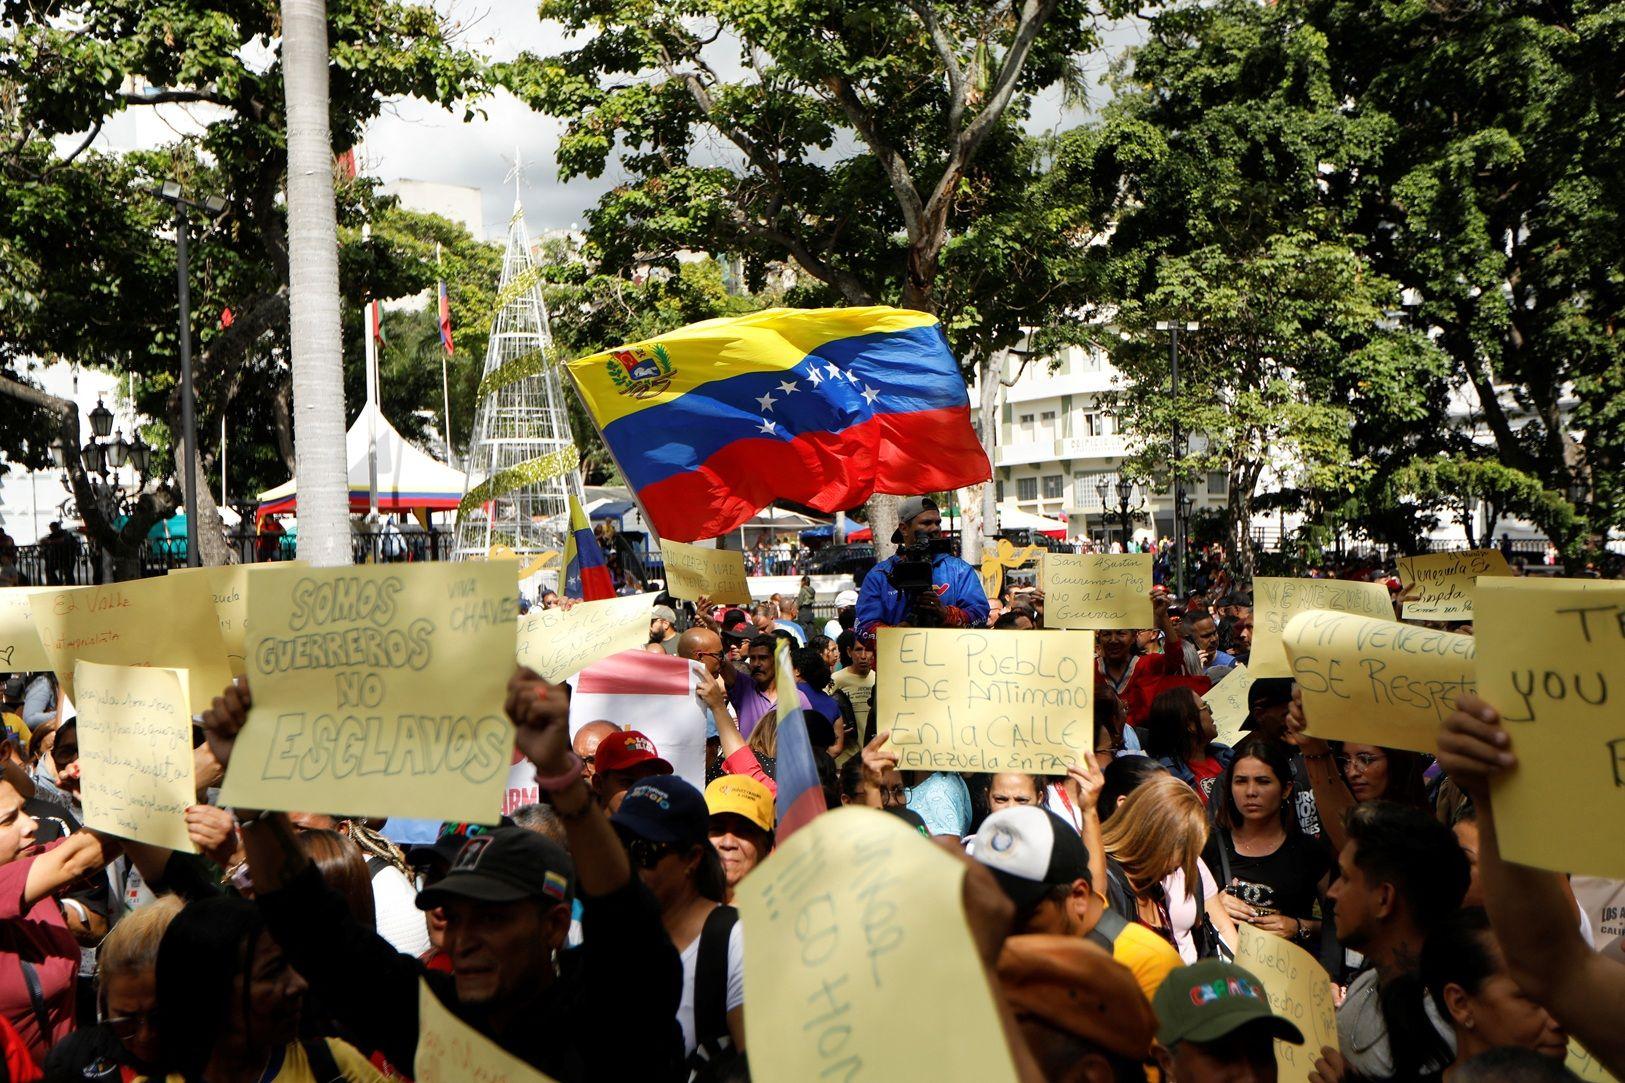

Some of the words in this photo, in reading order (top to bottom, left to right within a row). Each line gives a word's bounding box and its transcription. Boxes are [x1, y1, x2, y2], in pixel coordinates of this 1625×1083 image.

[682, 554, 709, 574] CRAZY
[713, 562, 738, 577] WAR
[1051, 555, 1082, 568] San
[1400, 557, 1467, 586] Venezuela
[447, 579, 478, 599] VIVA
[1051, 573, 1120, 586] Queremos
[1120, 573, 1145, 593] Paz
[1081, 593, 1092, 602] a
[1262, 581, 1391, 616] VENEZUELA
[288, 575, 403, 632] SOMOS
[1056, 604, 1128, 620] Guerra
[1296, 612, 1346, 647] MI
[255, 617, 435, 675] GUERREROS
[899, 631, 946, 667] EL
[335, 671, 386, 710] NO
[900, 676, 950, 702] DE
[1293, 655, 1352, 700] SE
[889, 712, 940, 746] En
[946, 705, 979, 750] la
[261, 712, 512, 785] ESCLAVOS
[1601, 906, 1618, 923] LOS
